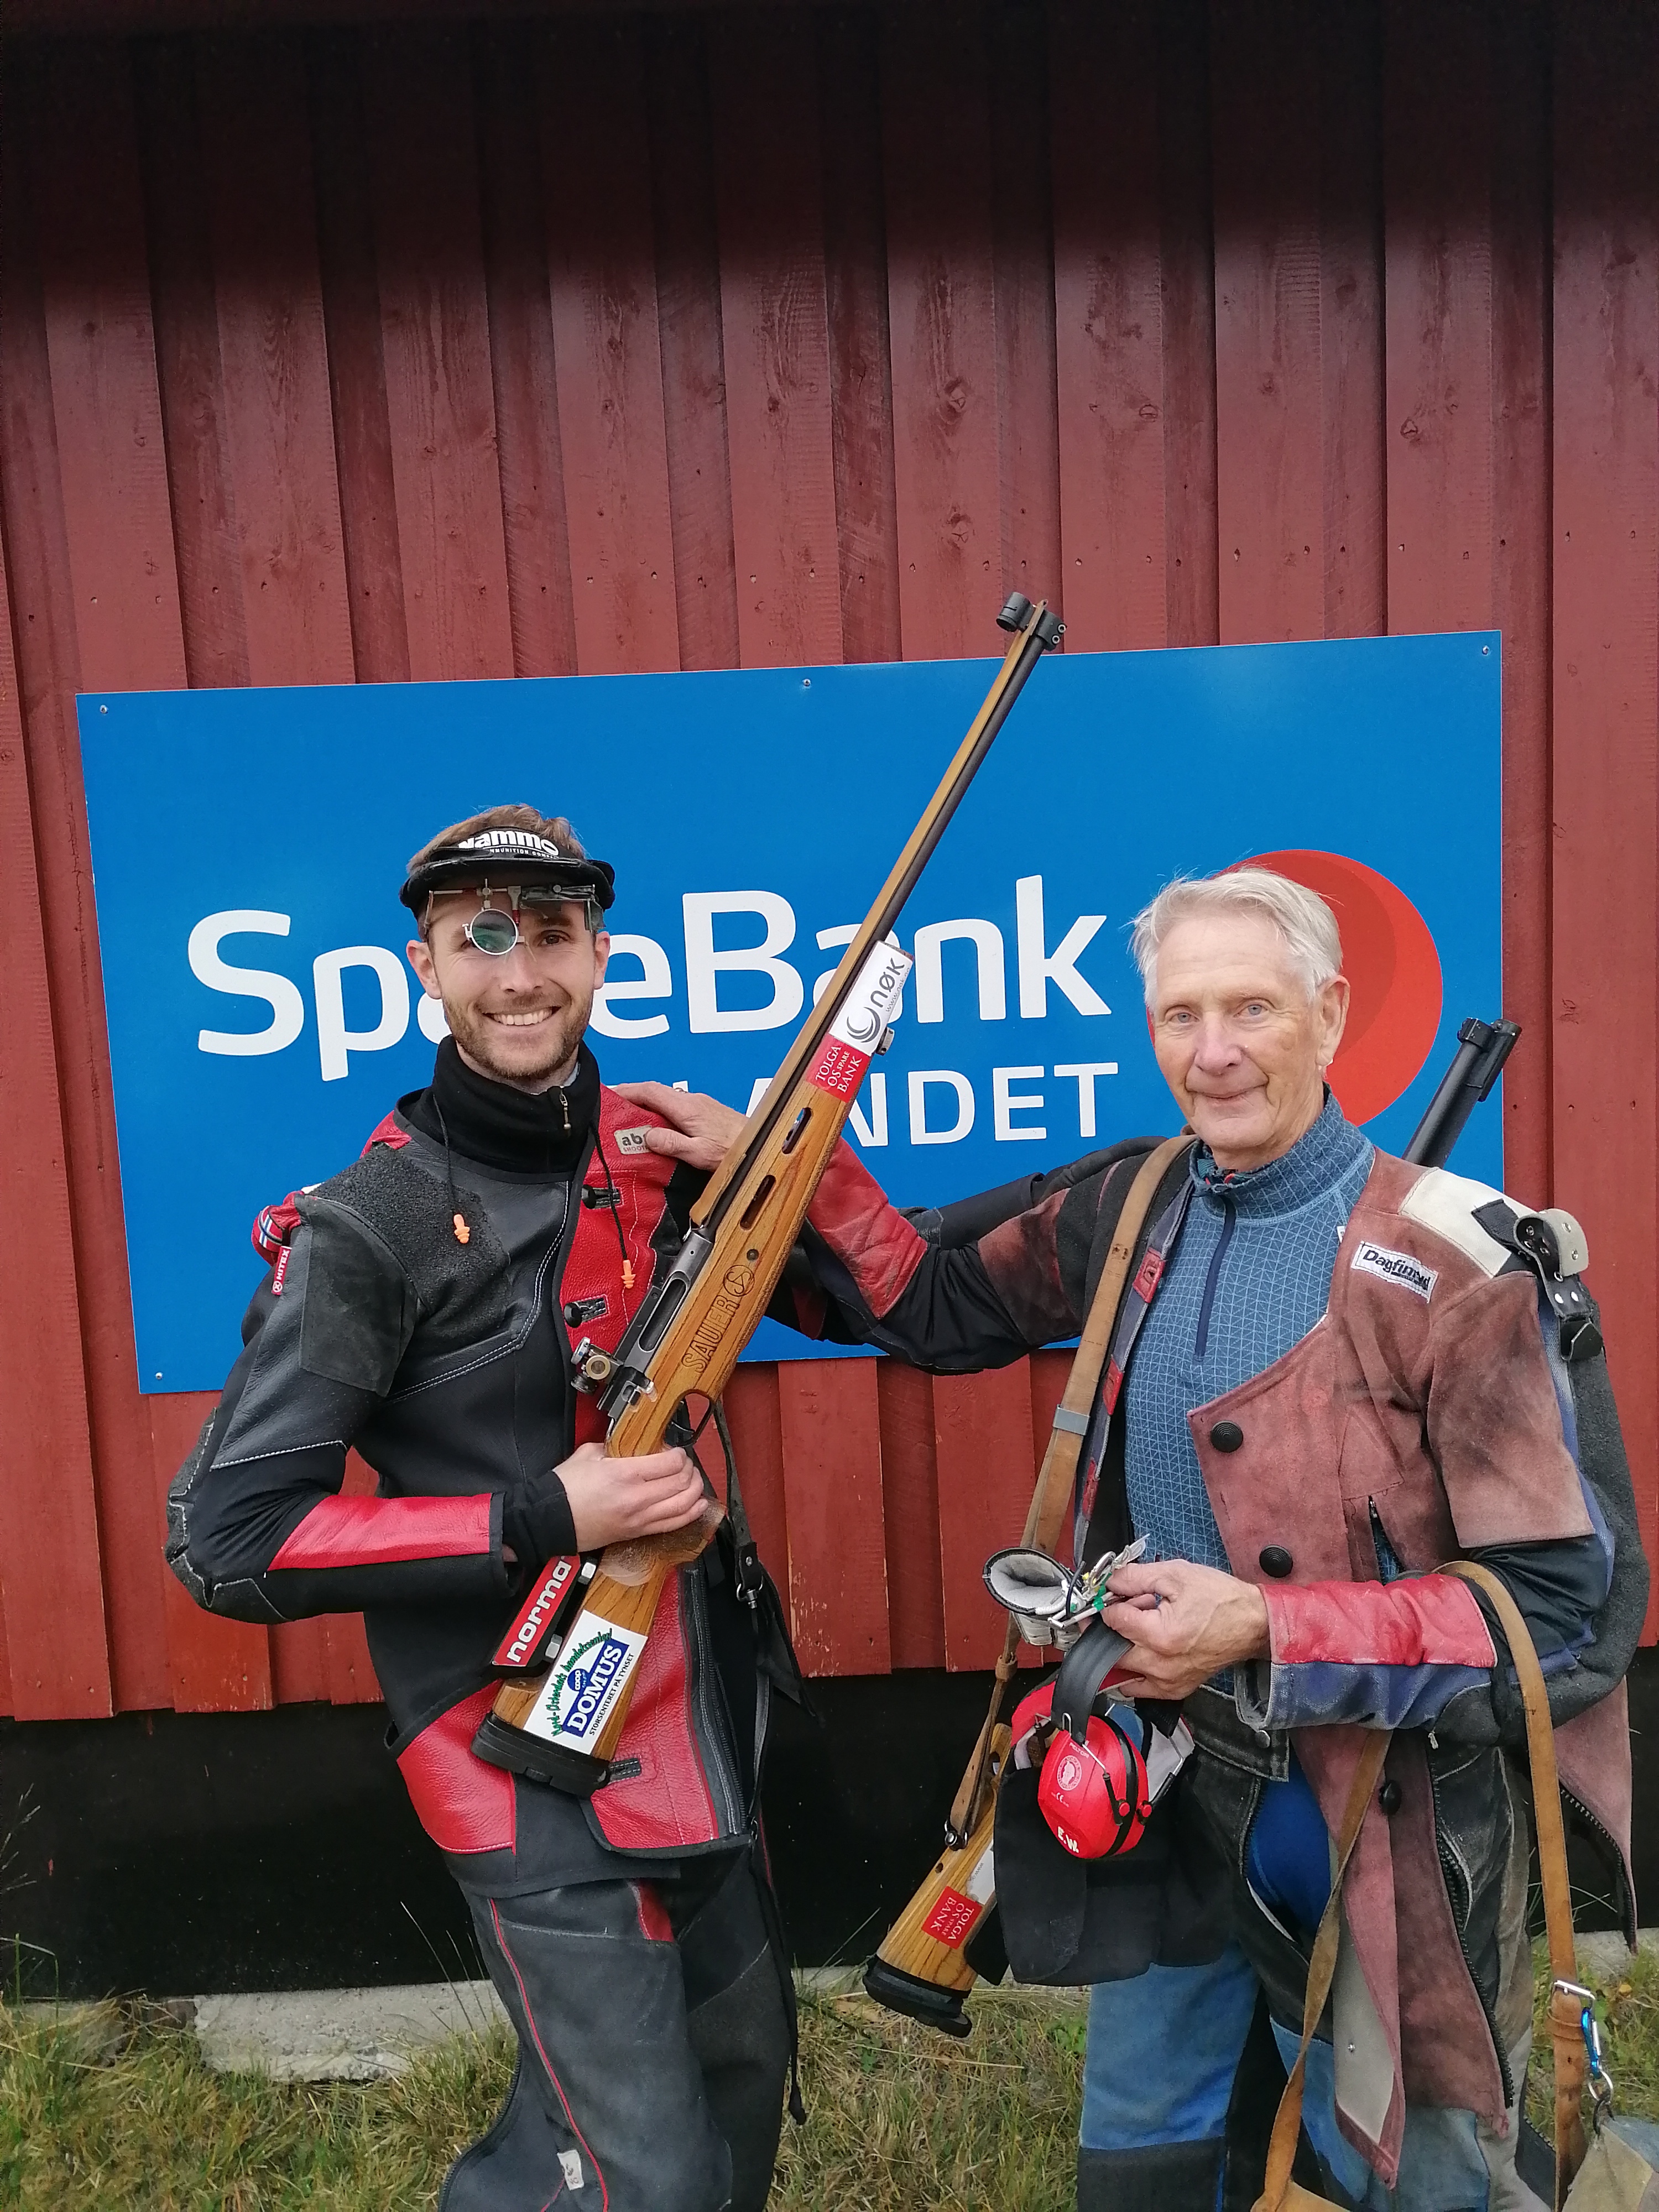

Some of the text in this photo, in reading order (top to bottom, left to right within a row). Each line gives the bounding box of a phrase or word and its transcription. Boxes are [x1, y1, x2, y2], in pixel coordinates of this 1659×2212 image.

[187, 874, 1112, 1082] SpeBnk
[816, 1046, 842, 1081] TOLGA
[827, 1051, 851, 1087] OS SPARE
[837, 1057, 863, 1093] BANK
[276, 1249, 290, 1280] HITEX
[682, 1295, 740, 1373] SAUER
[507, 1560, 572, 1663] norma
[567, 1645, 622, 1731] DOMUS
[589, 1653, 635, 1735] STORSENTERET PÅ TYNSET
[931, 1897, 957, 1931] BANK
[941, 1903, 964, 1936] OS SPARE
[947, 1908, 974, 1940] TOLGA
